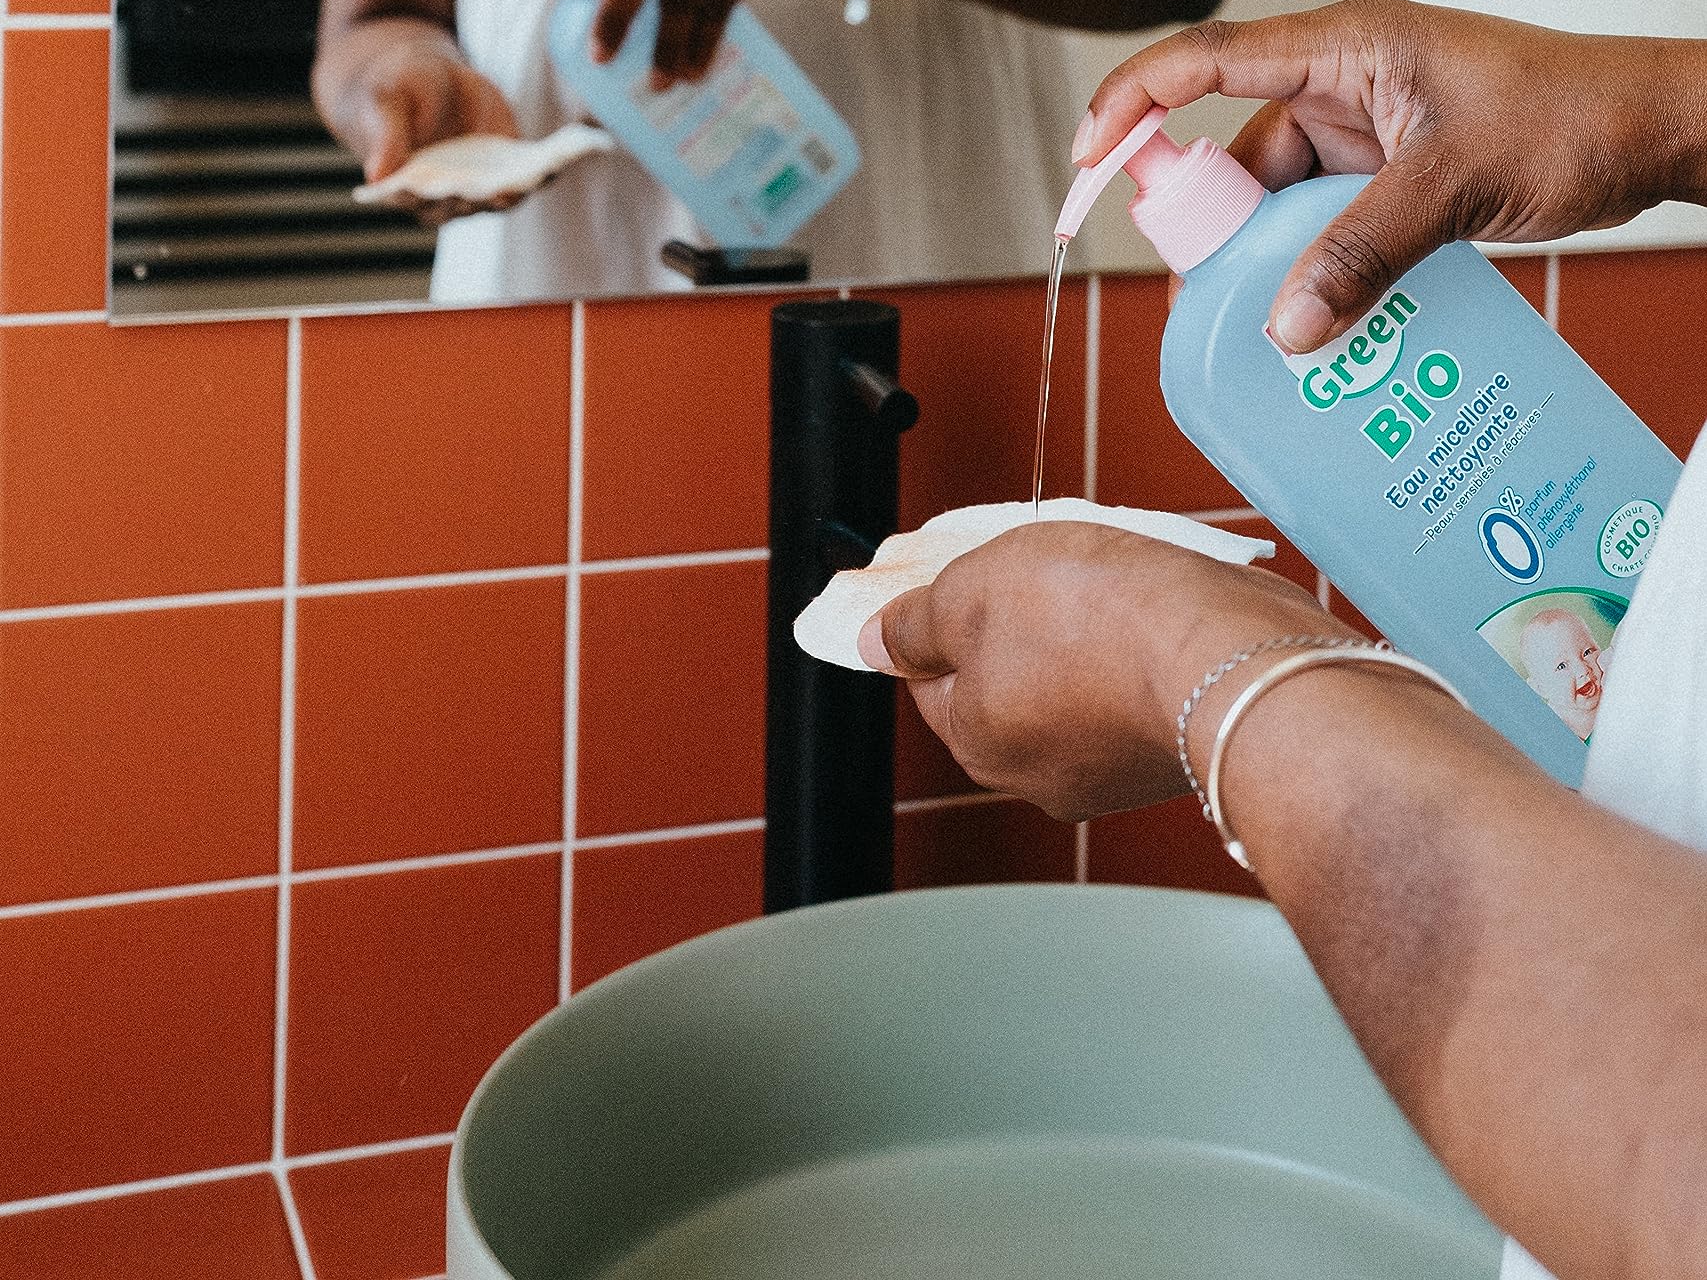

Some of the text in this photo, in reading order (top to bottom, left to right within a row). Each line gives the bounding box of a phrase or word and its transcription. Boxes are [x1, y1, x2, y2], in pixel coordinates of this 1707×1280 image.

[1302, 292, 1418, 409] Green
[1386, 374, 1509, 508] Eau micellaire
[1421, 404, 1517, 514] nettoyante
[1425, 410, 1541, 540] Peaux sensibles à réactives
[1524, 480, 1556, 520] parfum
[1537, 455, 1597, 534] phénoxyéthanol
[1545, 503, 1584, 549] allergène
[1604, 506, 1643, 554] COSMETIQUE
[1615, 519, 1650, 560] BIO
[1612, 559, 1644, 572] CHARTE
